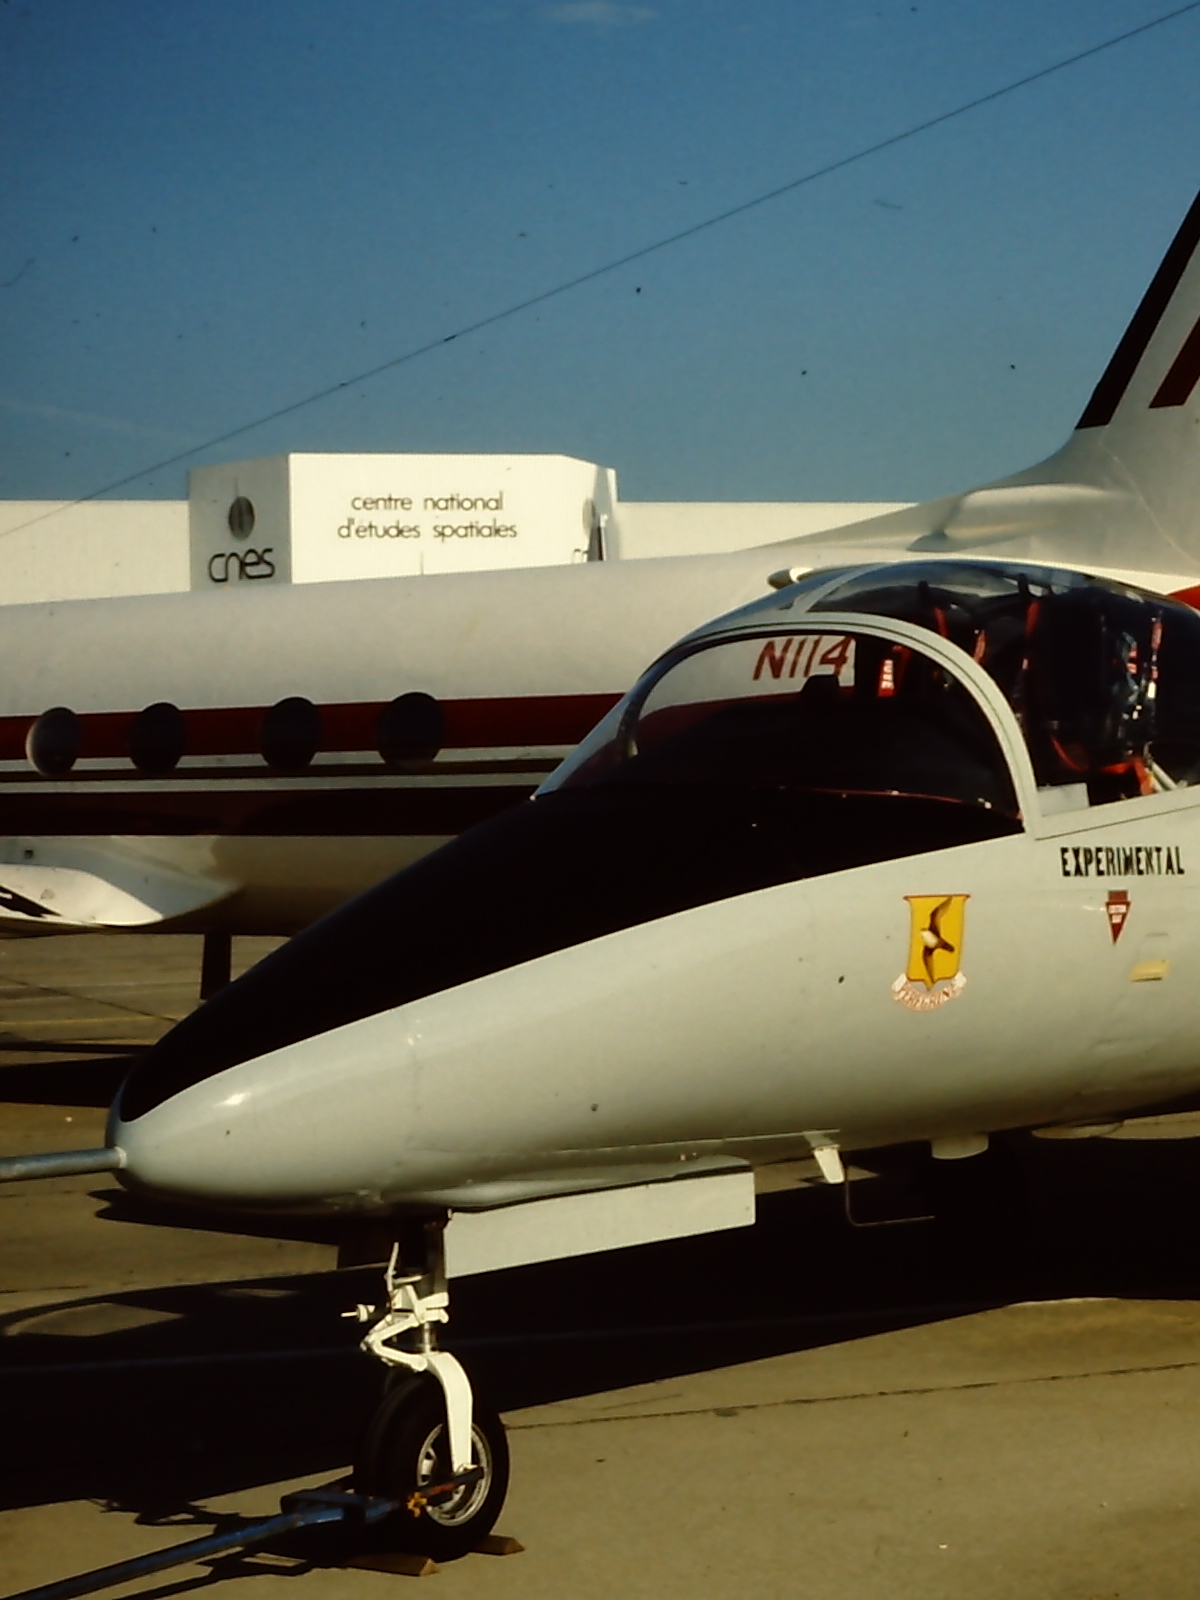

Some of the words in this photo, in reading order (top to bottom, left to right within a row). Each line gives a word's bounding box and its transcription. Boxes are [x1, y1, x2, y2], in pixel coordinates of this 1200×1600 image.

[351, 493, 413, 511] centre
[423, 491, 503, 511] national
[433, 518, 518, 543] spatiales
[208, 548, 275, 583] cnes
[1060, 845, 1185, 877] EXPERIMENTAL
